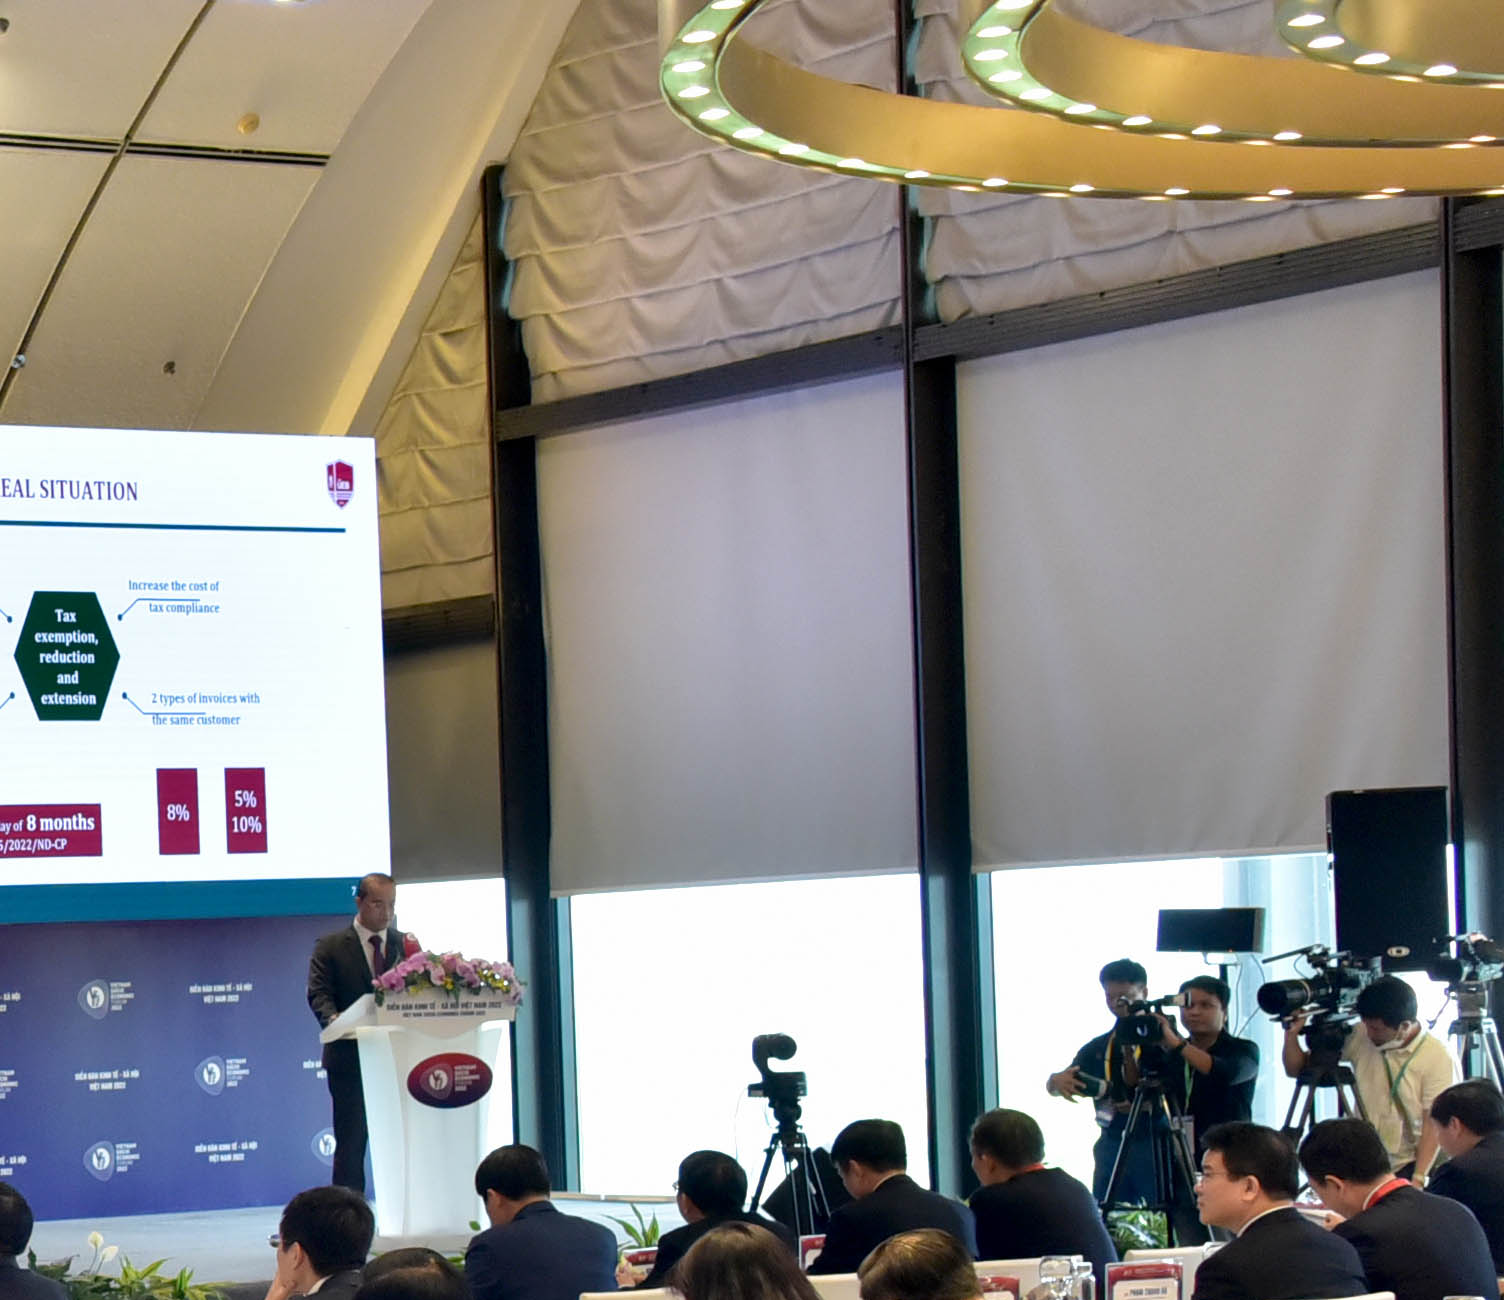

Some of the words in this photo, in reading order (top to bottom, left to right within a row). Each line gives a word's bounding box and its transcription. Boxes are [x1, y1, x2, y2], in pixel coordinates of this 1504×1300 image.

[40, 479, 138, 501] SITUATION
[54, 609, 77, 623] Tax
[34, 629, 99, 647] exemption,
[39, 649, 95, 664] reduction
[57, 670, 79, 684] and
[40, 691, 97, 705] extension
[234, 790, 257, 808] 5%
[167, 804, 190, 821] 8%
[12, 819, 23, 831] of
[26, 814, 37, 831] 8
[39, 813, 95, 831] months
[232, 816, 262, 833] 10%
